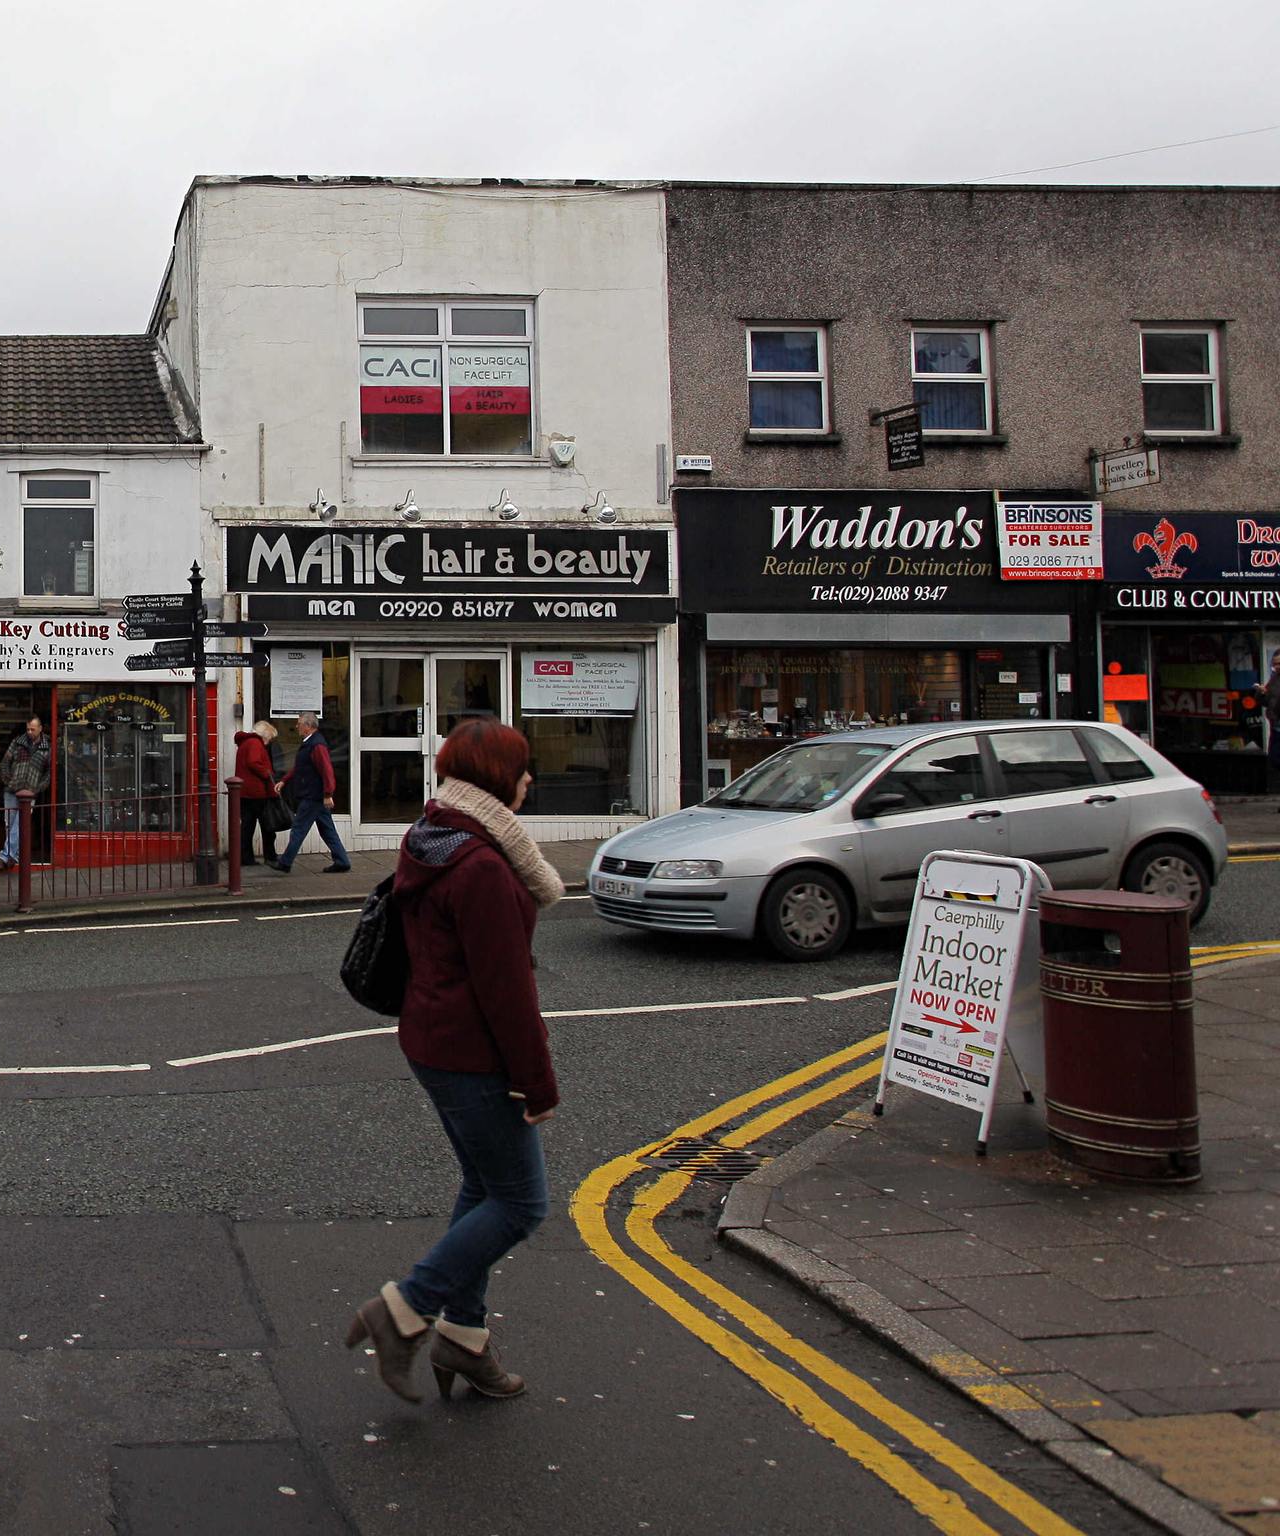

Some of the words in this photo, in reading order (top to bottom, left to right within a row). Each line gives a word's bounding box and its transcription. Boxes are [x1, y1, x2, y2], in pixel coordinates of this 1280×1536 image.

[364, 358, 437, 378] CACI
[450, 357, 472, 366] NON
[474, 357, 527, 366] SURGICAL
[464, 371, 490, 380] FACE
[493, 371, 513, 380] LIFT
[384, 395, 424, 404] LADIES
[476, 402, 517, 410] BEAUTY
[1108, 460, 1144, 475] Jewellery
[1128, 472, 1135, 480] &
[1005, 509, 1092, 523] BRINSONS
[770, 506, 983, 550] Waddon's
[1009, 534, 1040, 546] FOR
[1048, 534, 1090, 546] SALE
[247, 532, 406, 584] MANIC
[422, 533, 486, 573] hair
[495, 547, 514, 573] &
[526, 534, 651, 584] beauty
[1009, 556, 1030, 567] 029
[1033, 556, 1061, 567] 2086
[1065, 556, 1093, 566] 7711
[762, 556, 847, 576] Retailers
[851, 555, 875, 580] of
[885, 556, 992, 577] Distinction
[1008, 569, 1083, 578] www.brinsons.co.uk
[914, 586, 948, 601] 9347
[1117, 589, 1167, 608] CLUB
[1174, 590, 1187, 608] &
[308, 600, 355, 616] men
[379, 601, 443, 617] 02920
[451, 601, 514, 617] 851877
[533, 601, 617, 617] women
[0, 621, 32, 640] Key
[39, 621, 109, 640] Cutting
[31, 644, 41, 655] &
[48, 644, 114, 657] Engravers
[18, 658, 74, 672] Printing
[169, 668, 187, 677] No.
[539, 663, 568, 673] CACI
[74, 695, 115, 718] Keeping
[119, 693, 171, 719] Caerphilly
[1161, 690, 1227, 716] SALE
[934, 906, 1004, 934] Caerphilly
[920, 925, 1007, 966] Indoor
[913, 956, 1003, 1001] Market
[1040, 970, 1109, 997] ITTER
[910, 988, 951, 1011] NOW
[954, 999, 996, 1024] OPEN
[895, 1071, 917, 1083] Monday
[922, 1080, 947, 1093] Saturday
[948, 1088, 960, 1097] 9am
[917, 1069, 941, 1083] Opening
[942, 1077, 958, 1088] Hours
